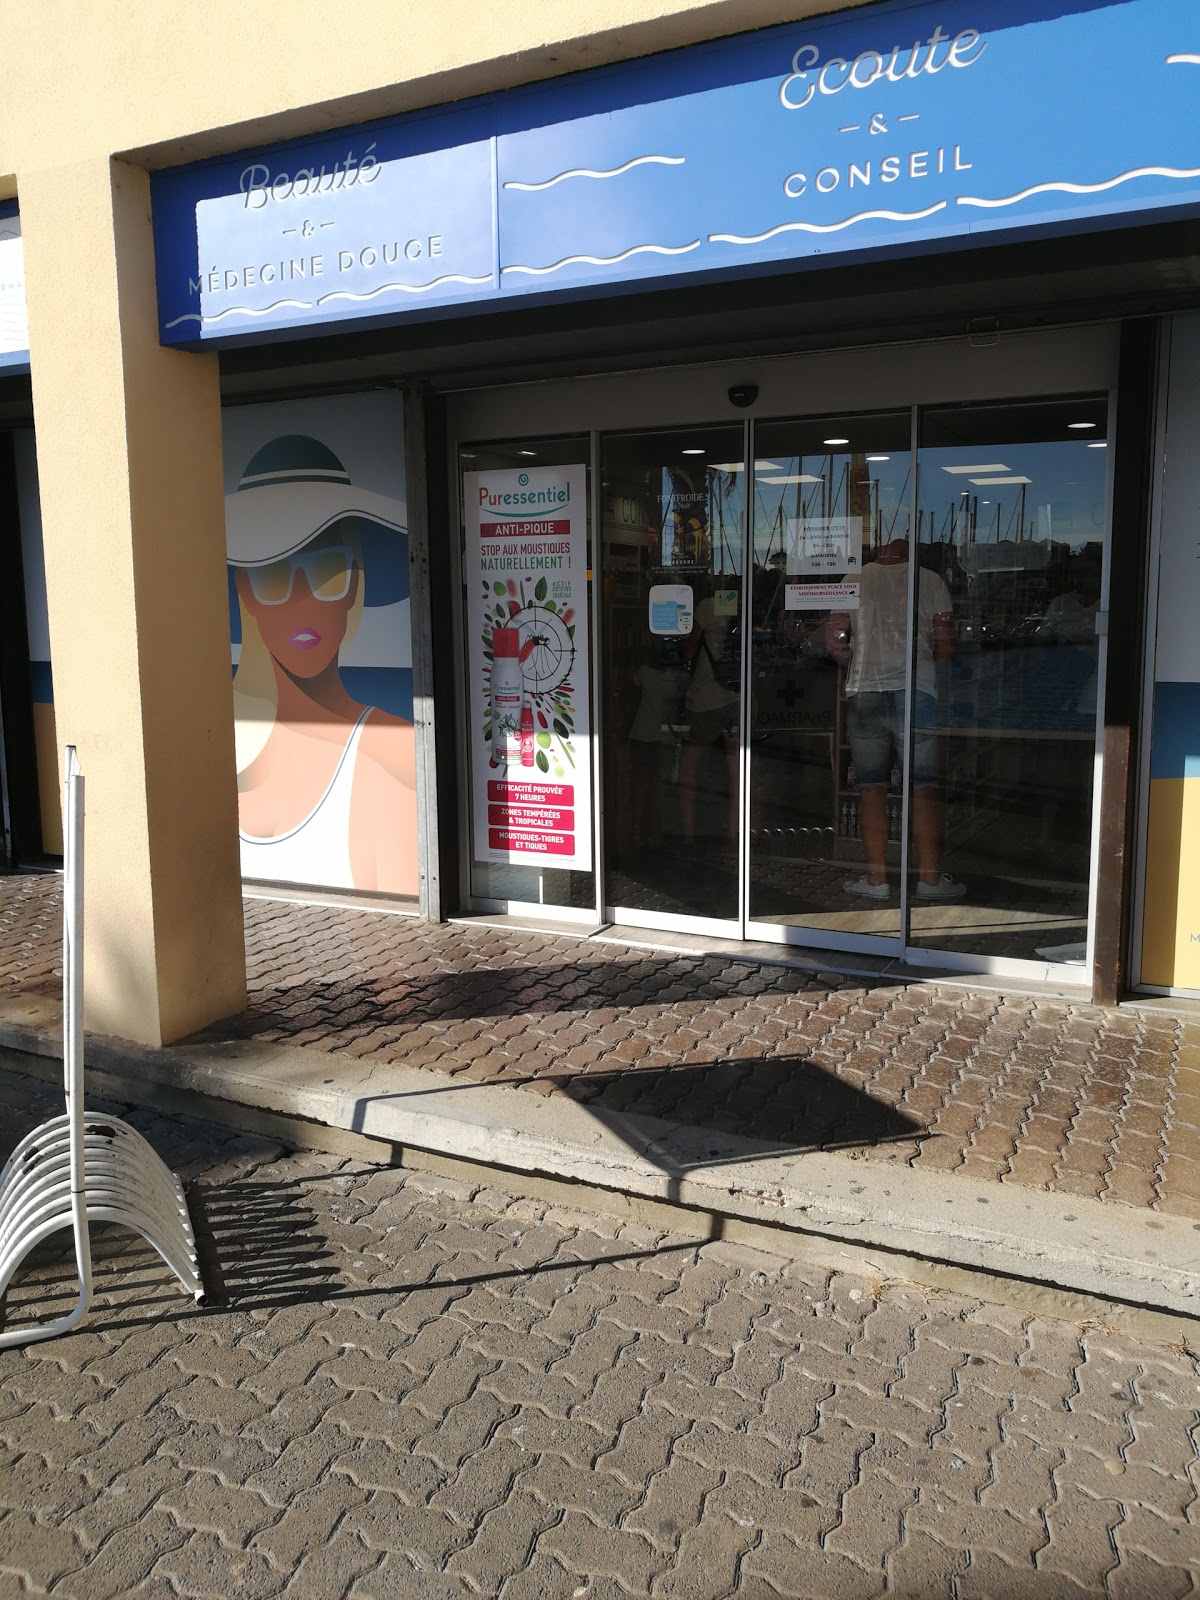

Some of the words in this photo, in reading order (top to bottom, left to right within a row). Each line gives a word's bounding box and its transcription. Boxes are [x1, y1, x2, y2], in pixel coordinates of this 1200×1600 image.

[779, 24, 988, 111] Ecoute
[868, 112, 888, 135] &
[239, 143, 382, 210] Beauté
[783, 144, 974, 198] CONSEIL
[301, 218, 316, 238] &
[188, 253, 325, 296] MÉDECINE
[338, 234, 443, 272] DOUCE
[479, 482, 571, 506] Puressentiel
[495, 522, 554, 536] ANTI-PIQUE
[481, 544, 500, 556] STOP
[502, 543, 518, 555] AUX
[520, 542, 570, 555] MOUSTIQUES
[481, 556, 563, 570] NATURELLEMENT
[496, 784, 532, 793] EFFICACITÉ
[520, 794, 546, 802] HEURES
[501, 808, 522, 817] ZONES
[523, 809, 560, 819] TEMPÉRÉES
[515, 818, 553, 827] TROPICALES
[499, 832, 564, 844] MOUSTIQUES-TIGRES
[515, 841, 524, 849] ET
[524, 842, 547, 851] TIQUES
